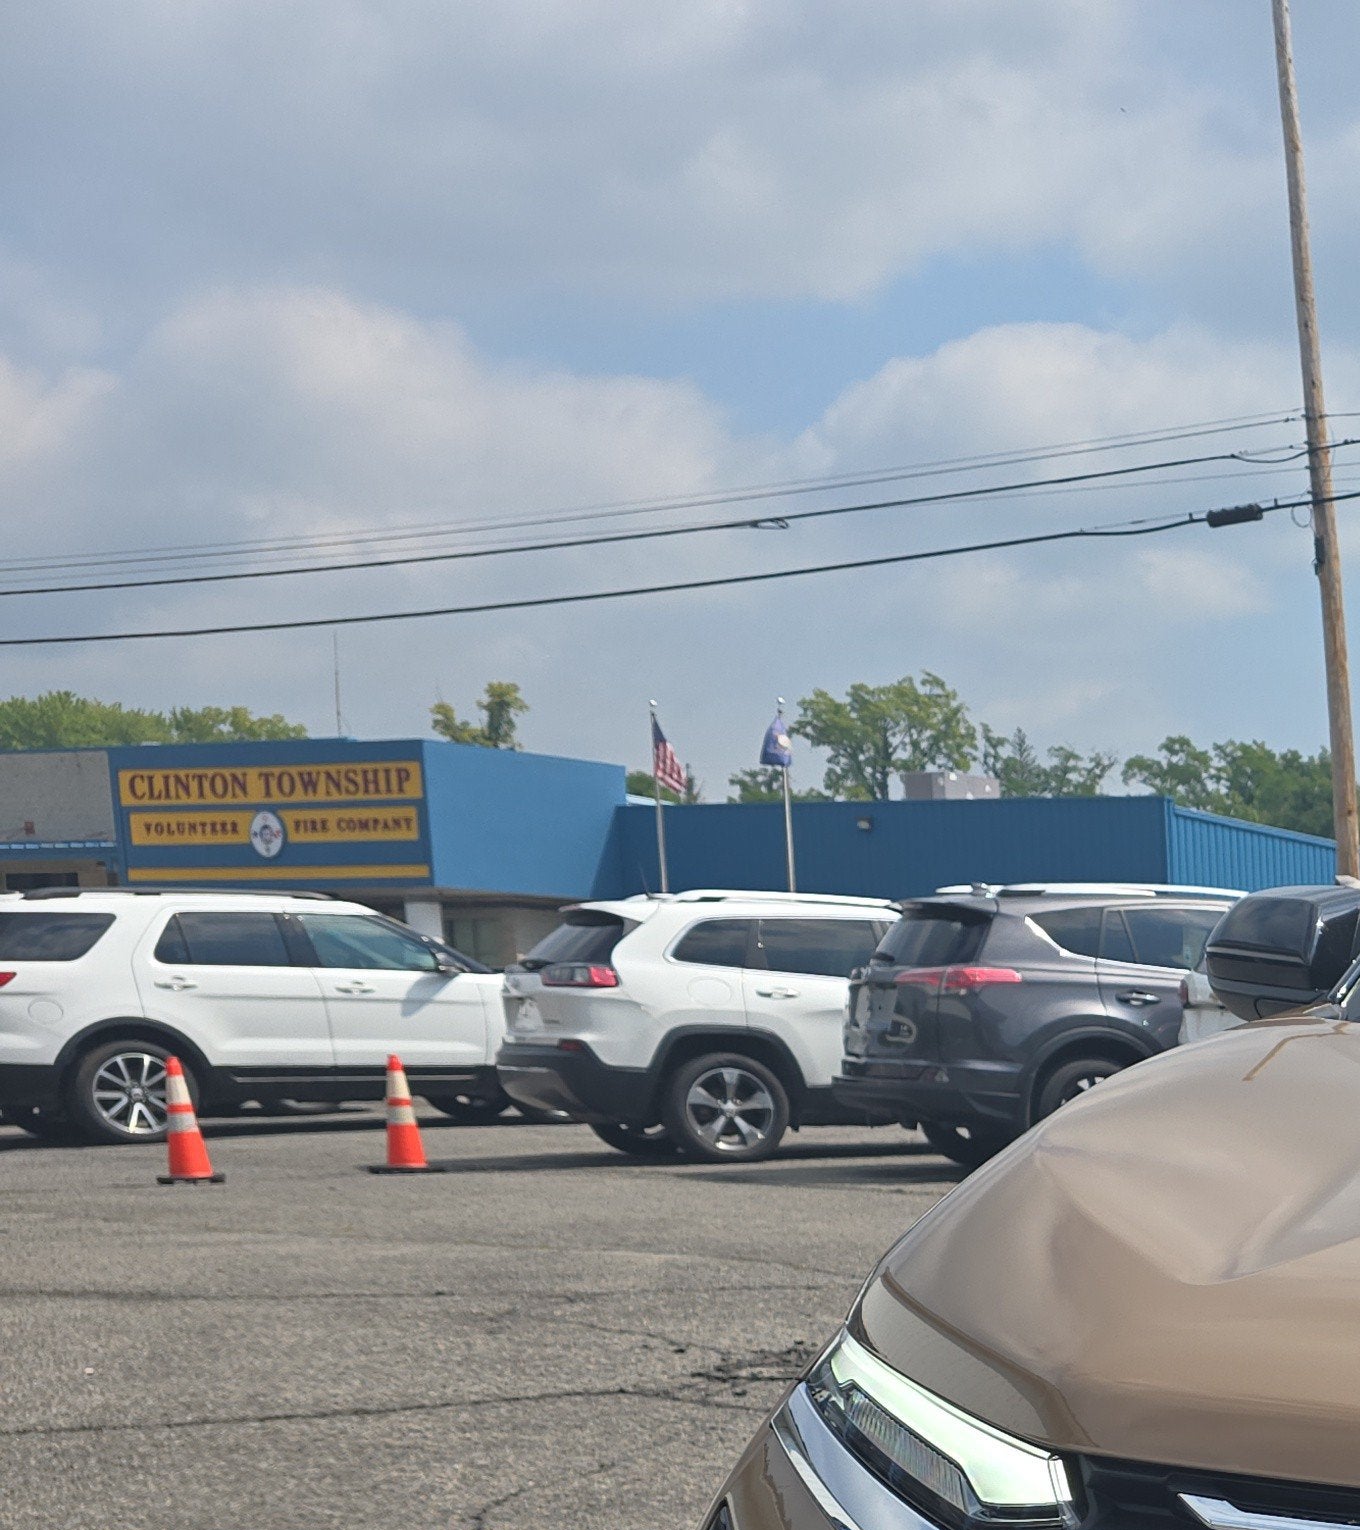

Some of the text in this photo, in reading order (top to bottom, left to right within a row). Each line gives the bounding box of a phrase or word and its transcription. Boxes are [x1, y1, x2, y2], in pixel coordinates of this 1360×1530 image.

[128, 768, 411, 800] CLINTON TOWNSHIP
[144, 816, 413, 836] VOLUNTEER FIRE COMPANY
